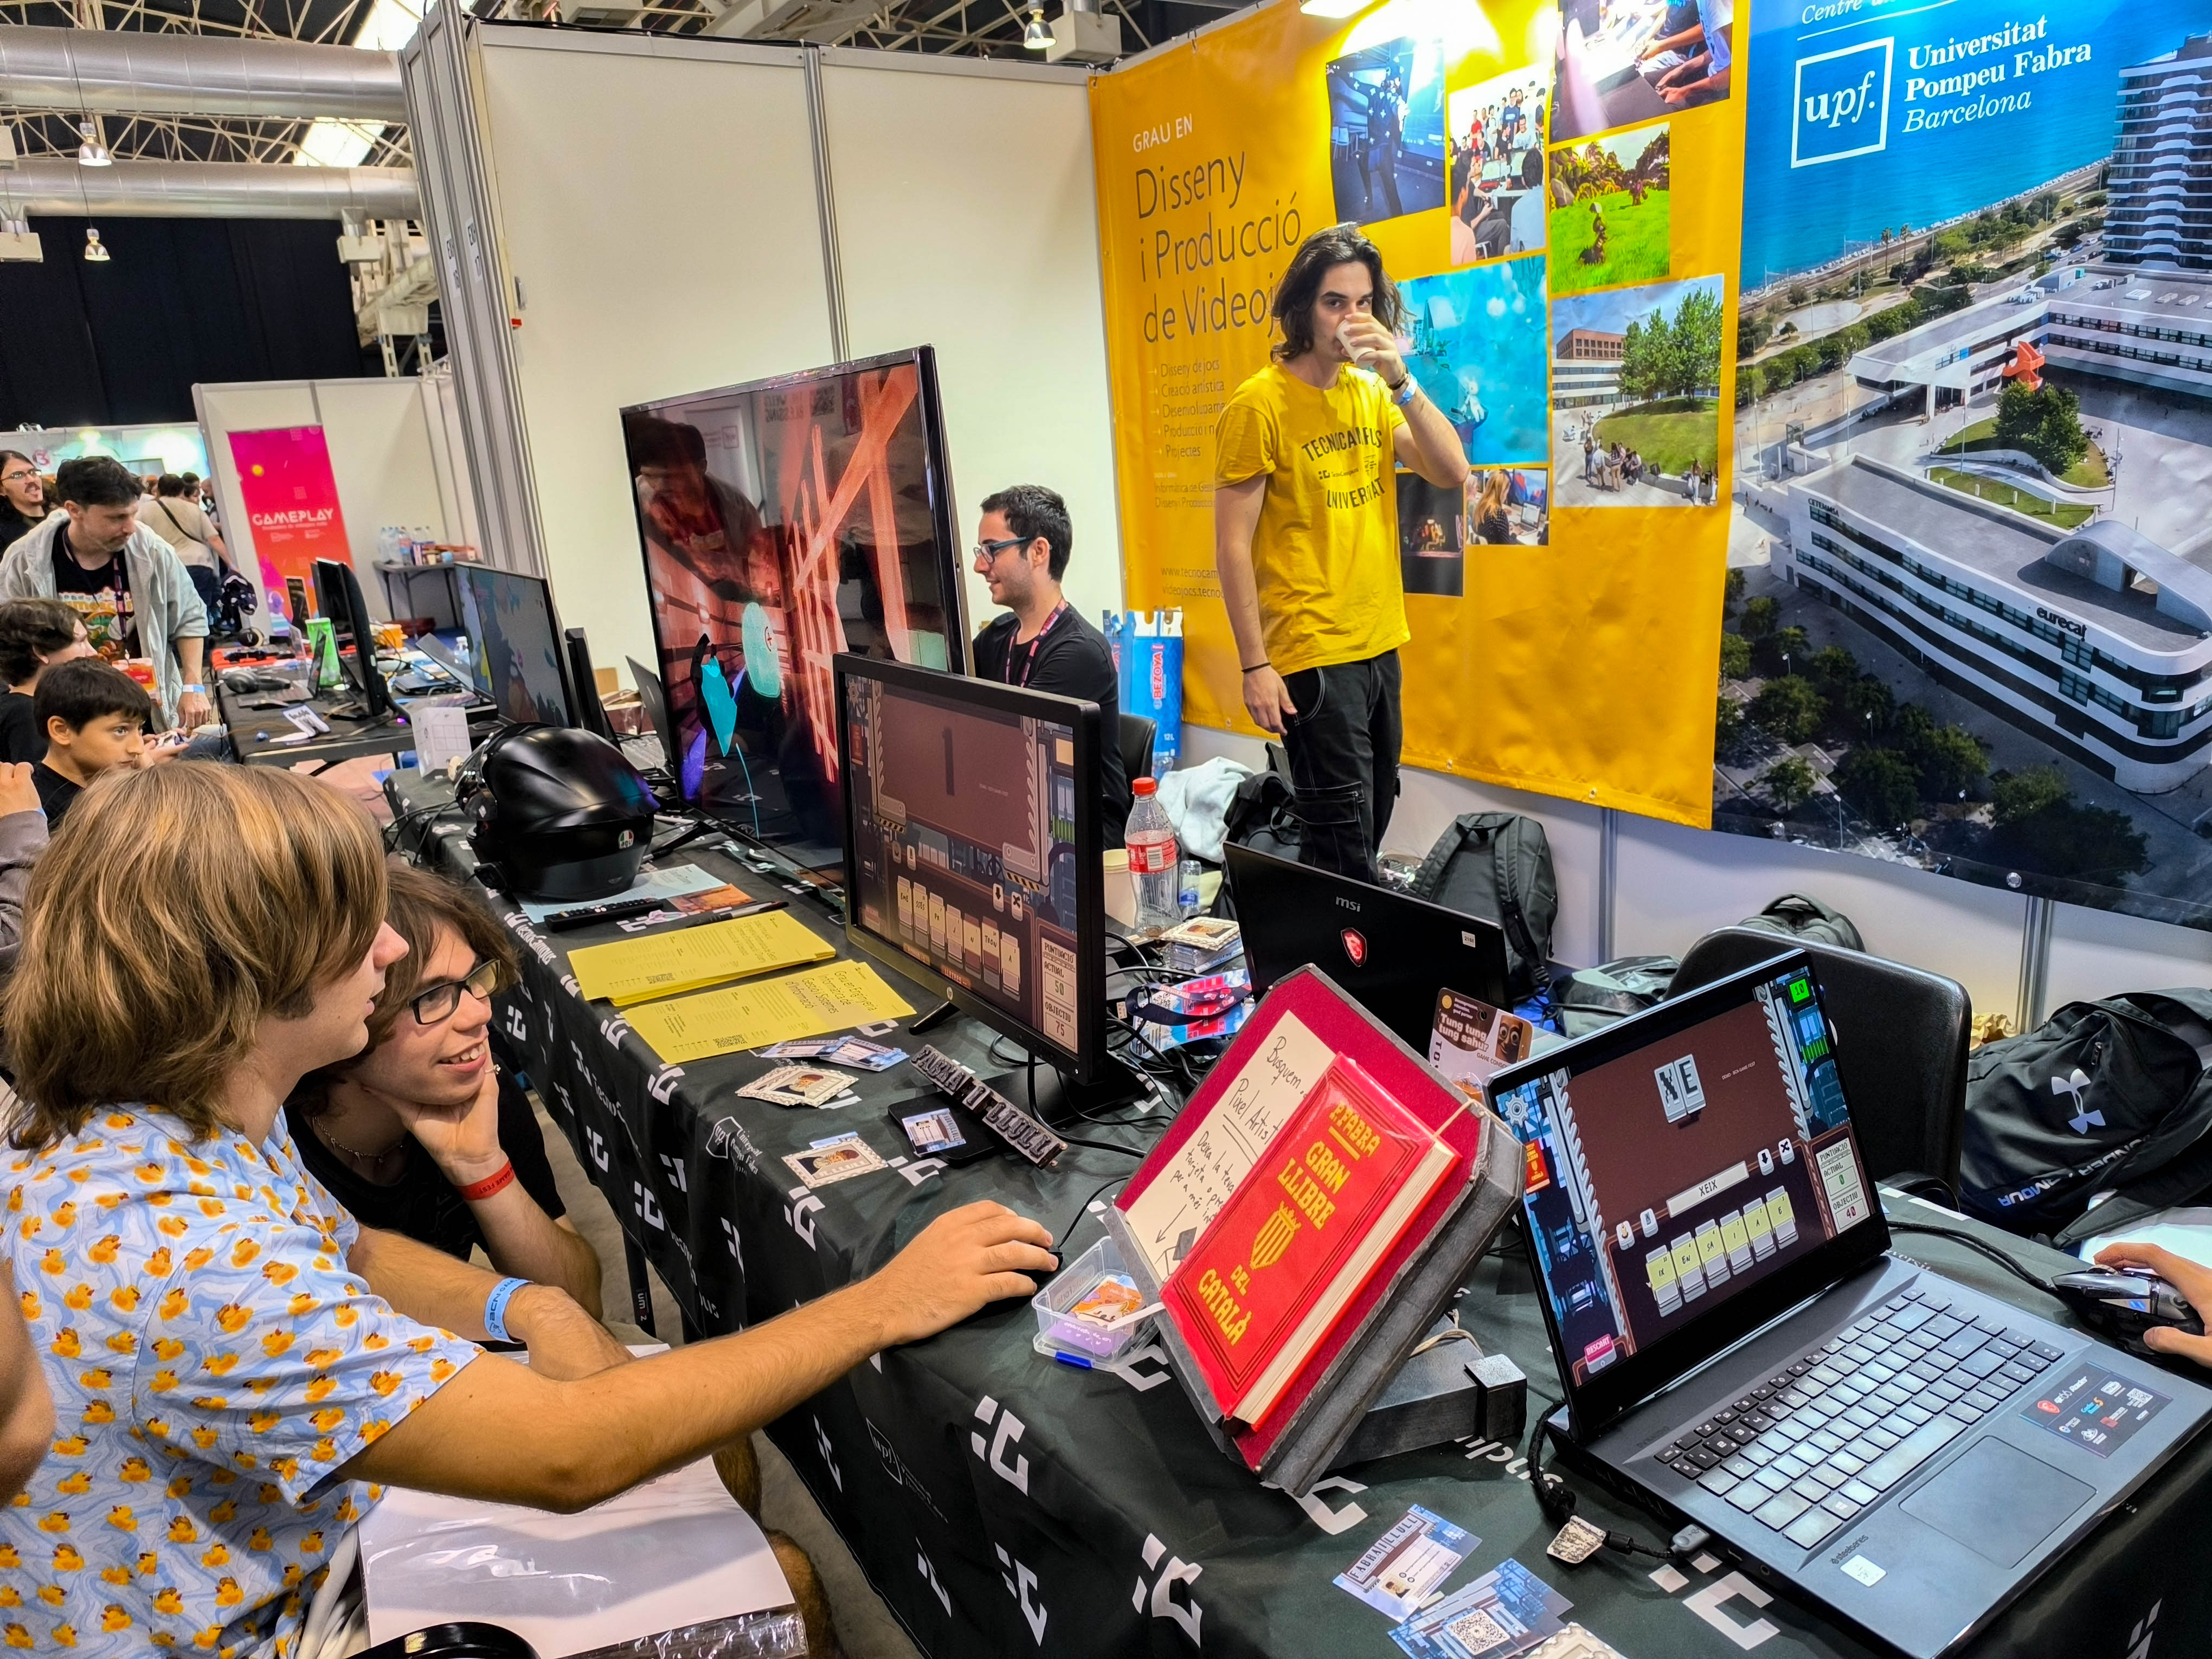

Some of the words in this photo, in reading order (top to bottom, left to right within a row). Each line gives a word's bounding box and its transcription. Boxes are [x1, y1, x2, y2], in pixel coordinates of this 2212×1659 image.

[1908, 14, 2047, 70] Universitat
[1904, 62, 2005, 102] Pompeu
[2014, 40, 2092, 78] Fabra
[1902, 89, 2032, 133] Barcelona
[1133, 123, 1172, 153] GRAU
[1175, 113, 1193, 136] EN
[1136, 151, 1246, 220] Disseny
[1140, 237, 1147, 282] i
[1156, 191, 1301, 279] Producció
[1144, 292, 1175, 344] de
[1182, 272, 1283, 338] Videoj
[1161, 363, 1191, 378] Disseny
[1193, 358, 1202, 373] de
[1203, 359, 1219, 375] jocs
[1161, 382, 1190, 397] Creació
[1192, 380, 1224, 394] artística
[1166, 445, 1201, 461] Projectes
[252, 508, 333, 526] GAMEPLAY
[1161, 568, 1220, 578] www.tecnocam
[1153, 651, 1163, 700] BEZOYA
[1335, 896, 1360, 912] msi
[985, 936, 996, 948] TRON
[1045, 942, 1073, 963] PUNTUACIÓ
[1045, 961, 1064, 978] ACTUAL
[1054, 980, 1064, 995] 50
[1795, 983, 1804, 995] 10
[1045, 1002, 1071, 1023] OBJECTIU
[1056, 1021, 1064, 1036] 75
[1441, 1013, 1463, 1030] Tung
[1465, 1023, 1487, 1041] tung
[1439, 1024, 1459, 1041] tung
[1461, 1034, 1488, 1052] sahur
[1477, 1053, 1490, 1062] GAME
[1490, 1058, 1507, 1068] CONSO
[1229, 1078, 1259, 1120] Pixel
[1245, 1106, 1284, 1145] Artist
[1820, 1140, 1848, 1161] PUNTUACIÓ
[1197, 1130, 1212, 1160] Deixa
[1212, 1150, 1226, 1174] la
[1221, 1163, 1234, 1193] teva
[1305, 1141, 1351, 1195] GRAN
[1824, 1162, 1843, 1177] ACTUAL
[1170, 1170, 1184, 1182] per
[1184, 1184, 1188, 1192] a
[1699, 1180, 1718, 1197] XEIX
[1277, 1158, 1336, 1230] LLIBRE
[1833, 1191, 1858, 1210] OBJECTIU
[1847, 1206, 1856, 1219] 40
[1707, 1241, 1714, 1252] SA
[1682, 1255, 1690, 1264] EN
[1230, 1264, 1250, 1296] DEL
[1658, 1268, 1664, 1276] IX
[490, 1294, 500, 1321] BCN
[1198, 1268, 1252, 1346] CATALÀ
[1586, 1336, 1610, 1355] DESCART
[1350, 1548, 1382, 1578] FABRA
[1385, 1517, 1418, 1543] LLULL
